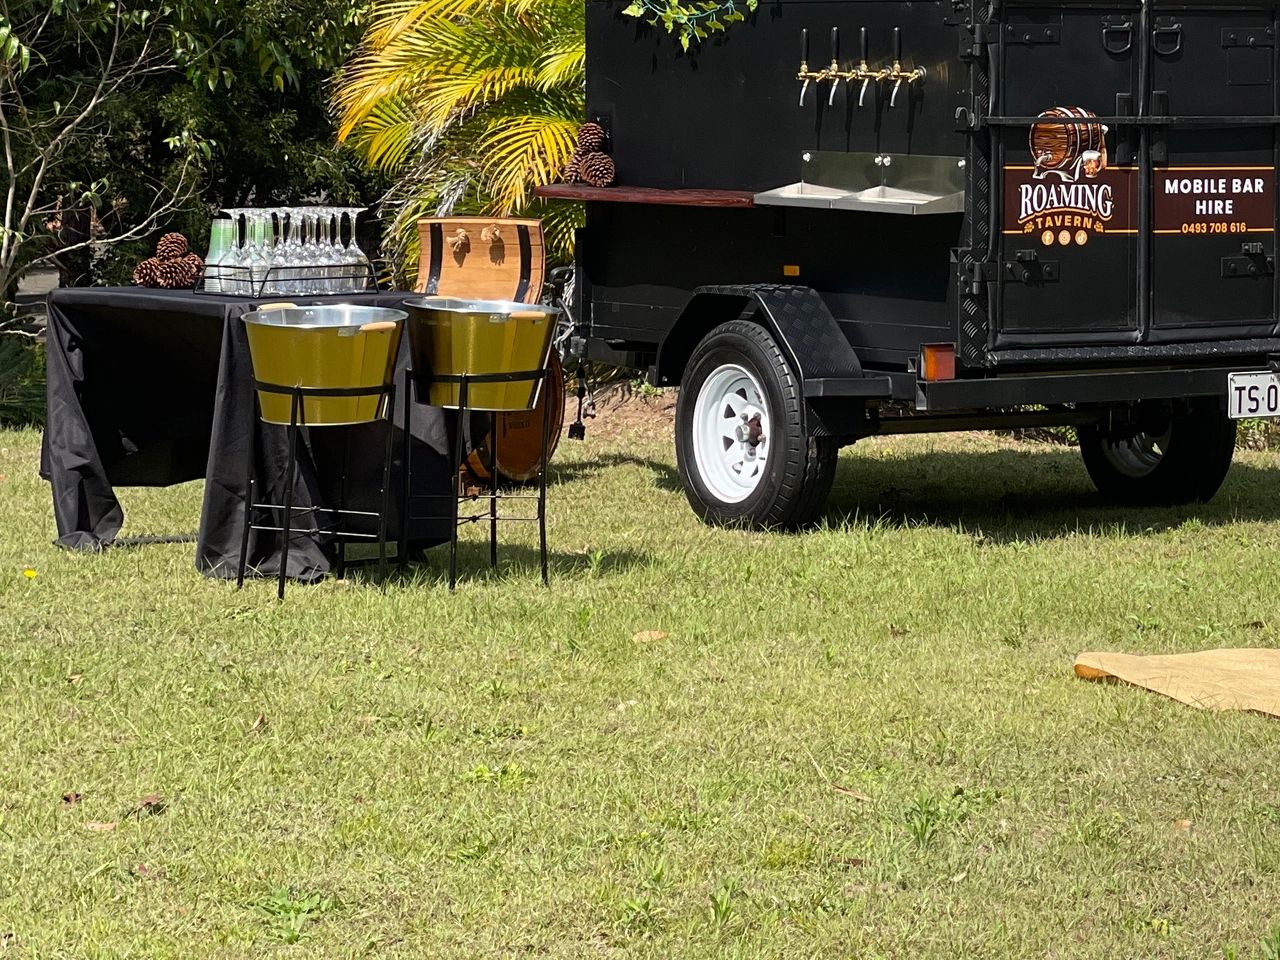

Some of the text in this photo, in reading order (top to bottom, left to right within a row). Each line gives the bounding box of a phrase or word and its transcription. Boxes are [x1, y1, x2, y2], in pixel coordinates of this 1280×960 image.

[1164, 178, 1265, 194] MOBILE BAR
[1018, 183, 1115, 220] ROAMING
[1195, 199, 1234, 215] HIRE
[1035, 215, 1093, 229] TAVERN
[1181, 222, 1247, 234] 0493 708 616
